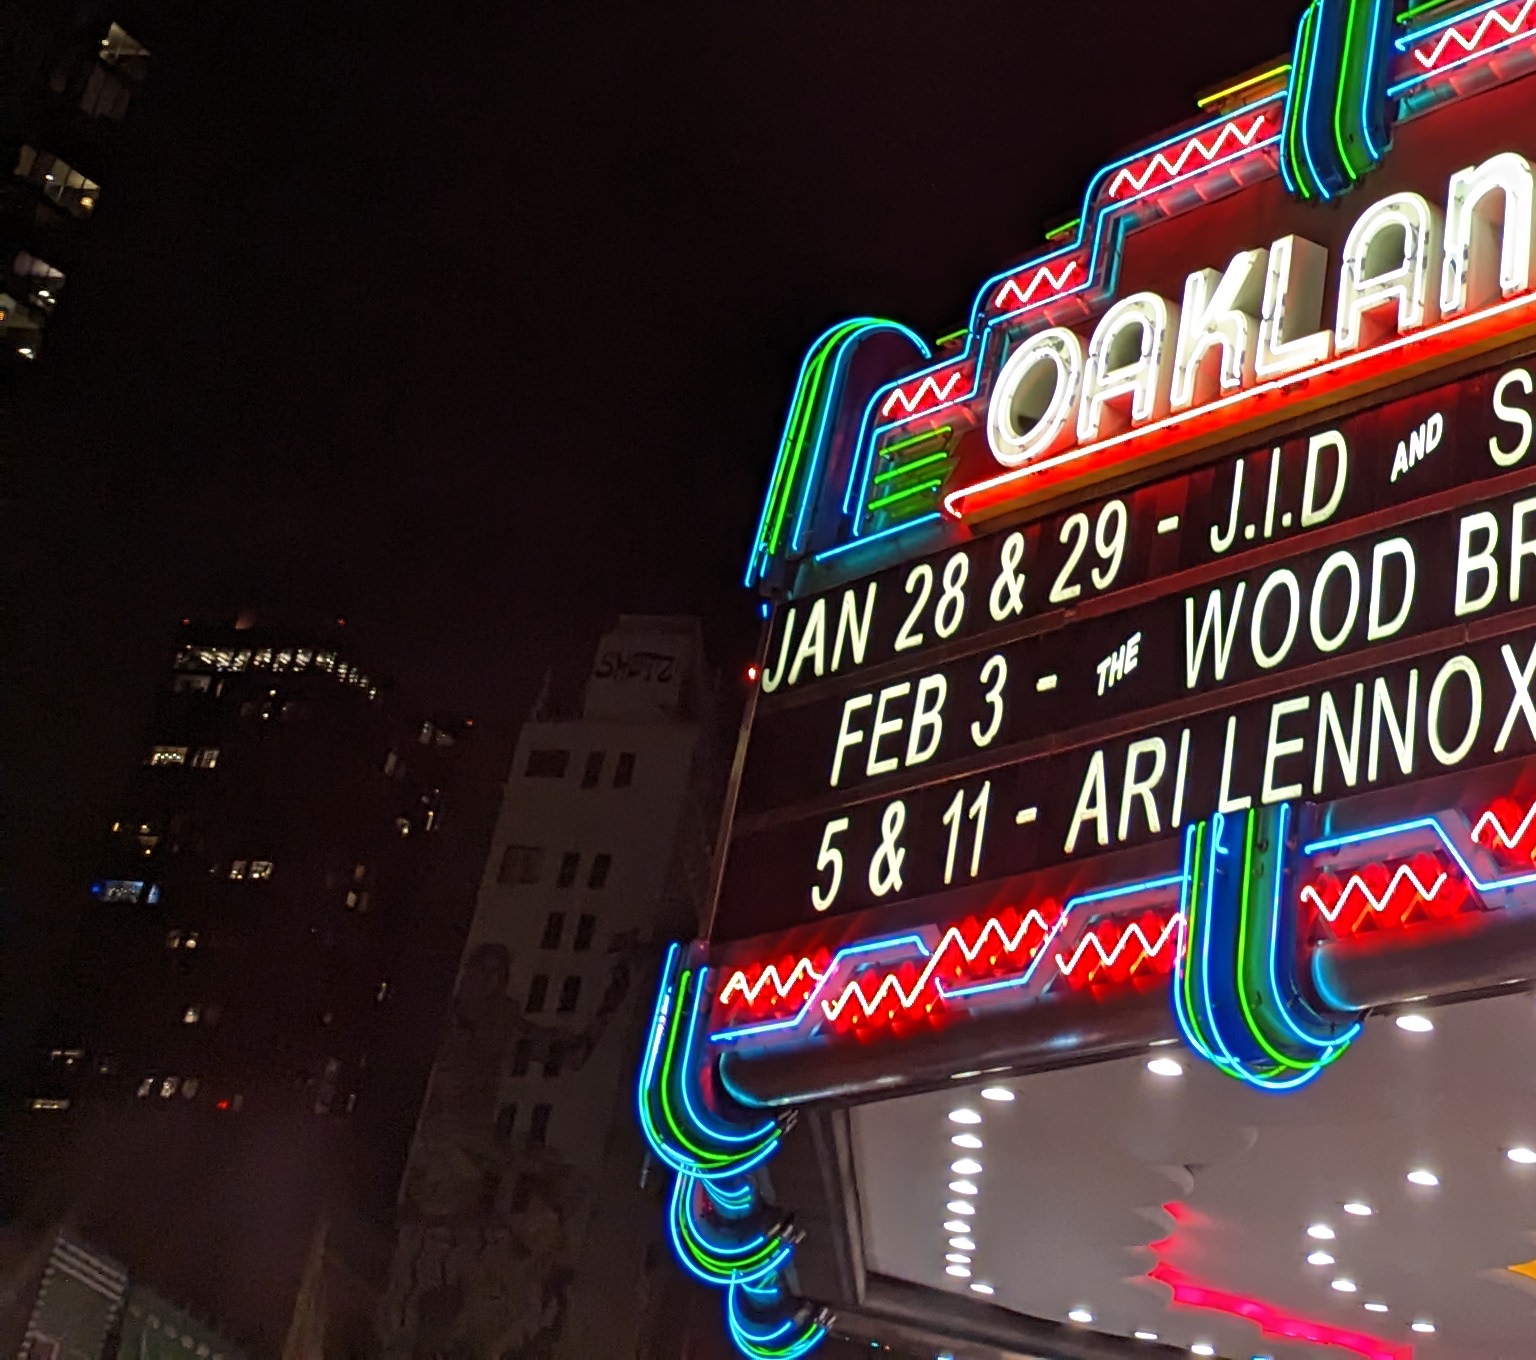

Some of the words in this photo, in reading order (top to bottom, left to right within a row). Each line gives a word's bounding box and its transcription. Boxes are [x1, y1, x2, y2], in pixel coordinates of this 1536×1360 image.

[761, 581, 878, 694] JAN
[895, 552, 970, 654] 28
[989, 531, 1025, 623] &
[1049, 498, 1127, 605] 29
[1209, 428, 1348, 553] J.I.D
[1390, 412, 1444, 483] AND
[830, 673, 947, 788] FEB
[971, 654, 1010, 749] 3
[1096, 632, 1142, 697] THE
[1184, 538, 1417, 691] WOOD
[810, 817, 848, 912] 5
[868, 800, 907, 898] &
[941, 780, 992, 885] 11
[1065, 728, 1192, 854] ARI
